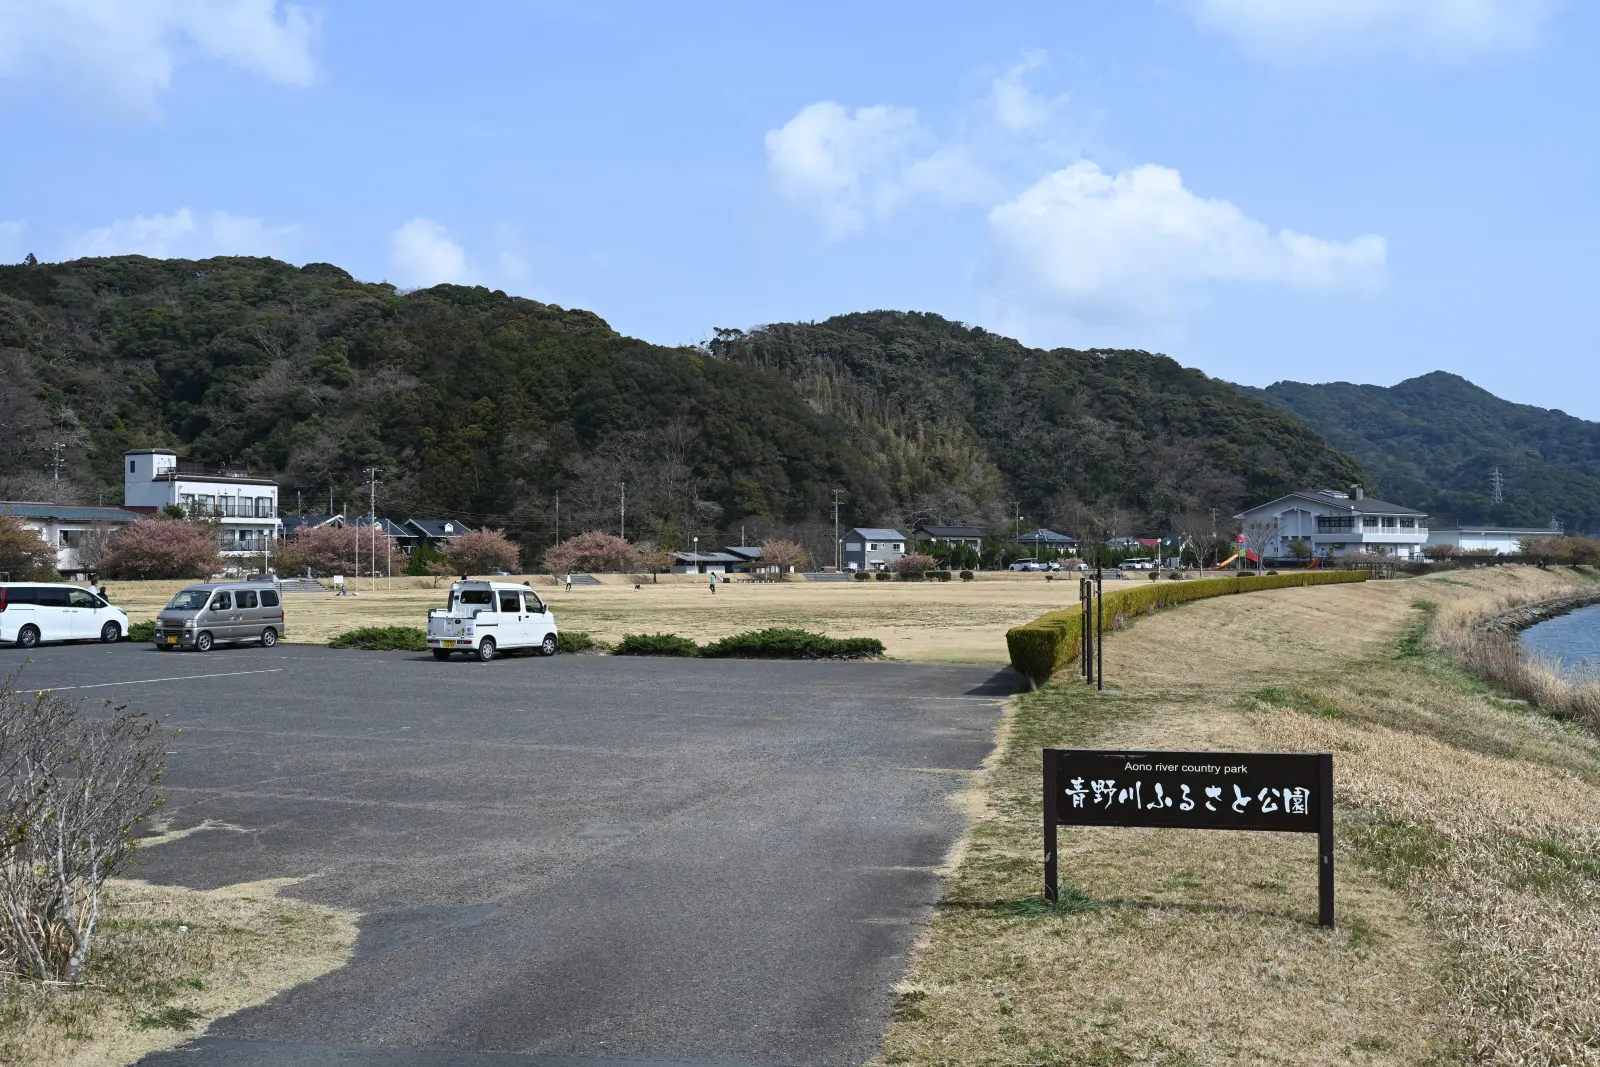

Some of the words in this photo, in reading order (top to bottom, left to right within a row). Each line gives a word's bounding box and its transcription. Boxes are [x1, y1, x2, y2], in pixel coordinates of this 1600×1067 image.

[1124, 762, 1152, 772] Aono
[1155, 762, 1179, 772] river
[1181, 764, 1221, 775] country
[1224, 764, 1248, 775] park
[1064, 776, 1310, 815] 青野川ふるさと公園
